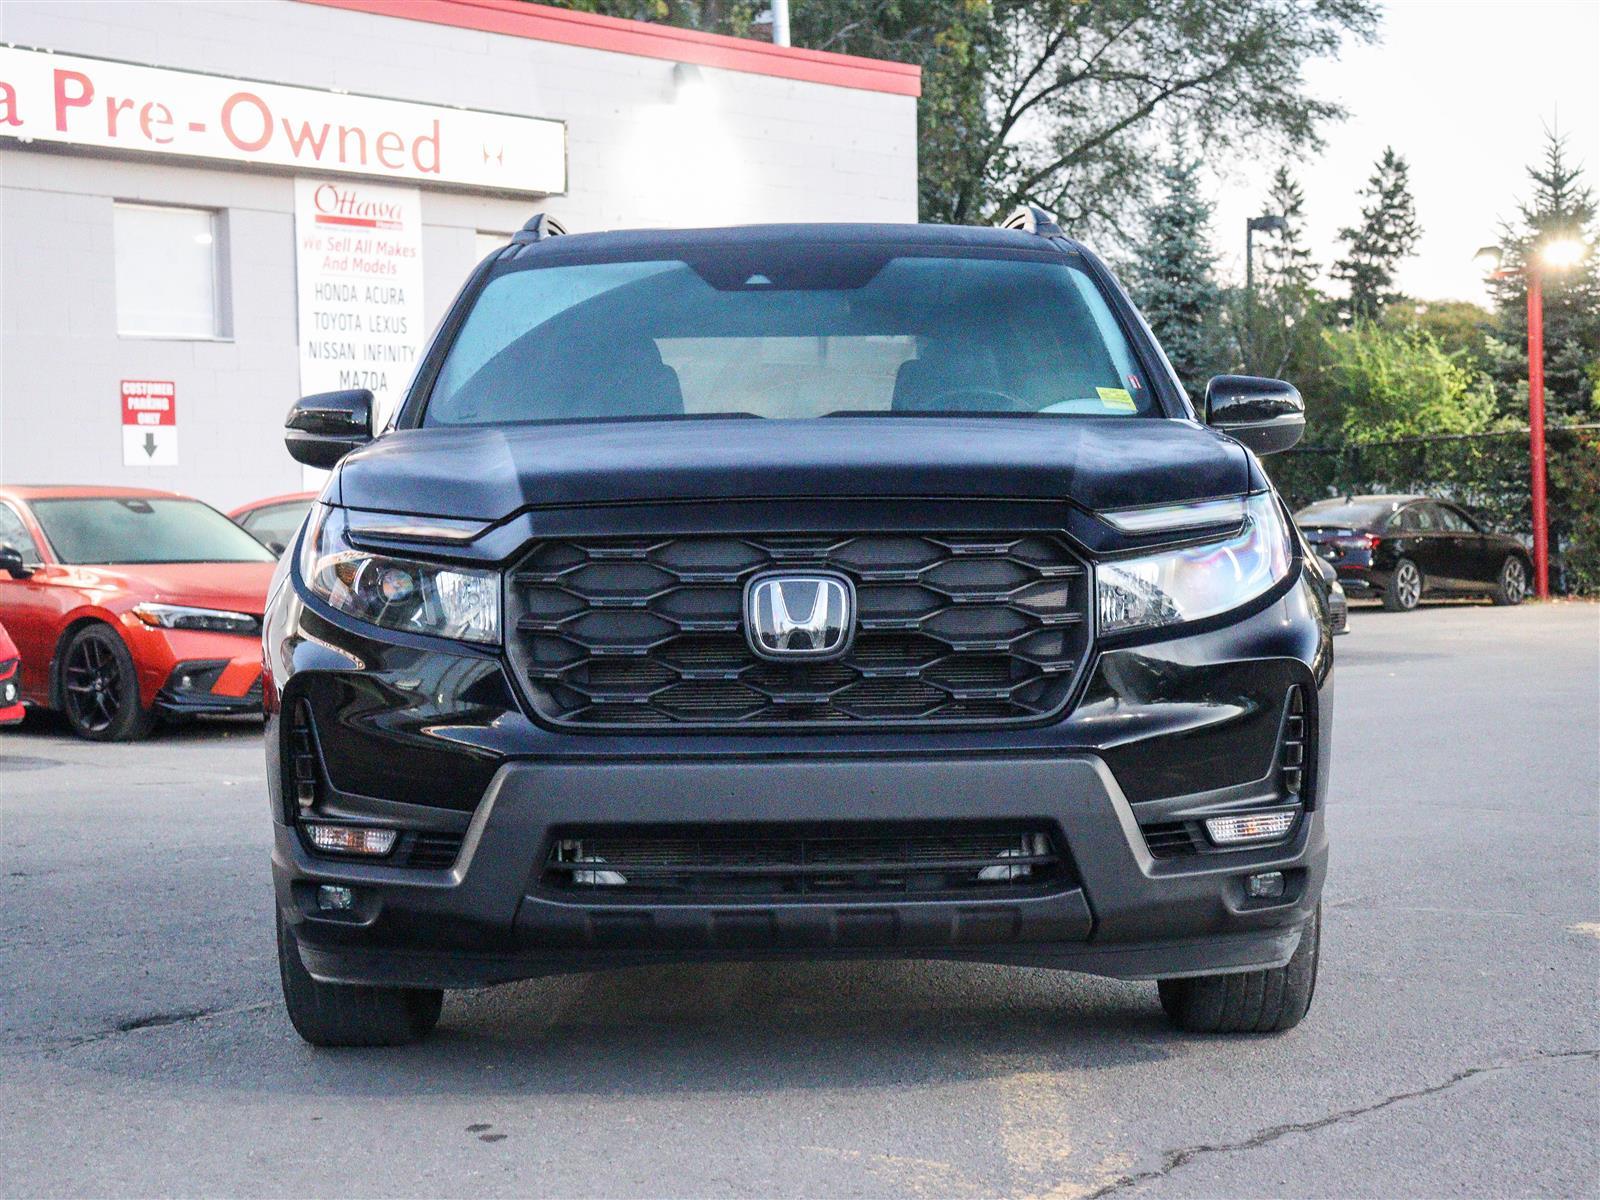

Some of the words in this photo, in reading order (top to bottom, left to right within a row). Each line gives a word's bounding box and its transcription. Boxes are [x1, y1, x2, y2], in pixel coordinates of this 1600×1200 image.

[53, 68, 441, 175] Pre-Owned
[313, 182, 403, 220] Ottawa
[303, 238, 321, 251] We
[327, 237, 351, 252] Sell
[354, 239, 372, 254] All
[376, 240, 416, 257] Makes
[322, 255, 348, 271] And
[352, 257, 397, 275] Models
[314, 282, 358, 302] HONDA
[365, 285, 405, 305] ACURA
[313, 311, 362, 332] TOYOTA
[369, 315, 408, 335] LEXUS
[308, 341, 355, 360] NISSAN
[363, 343, 416, 363] INFINITY
[339, 369, 388, 392] MAZDA
